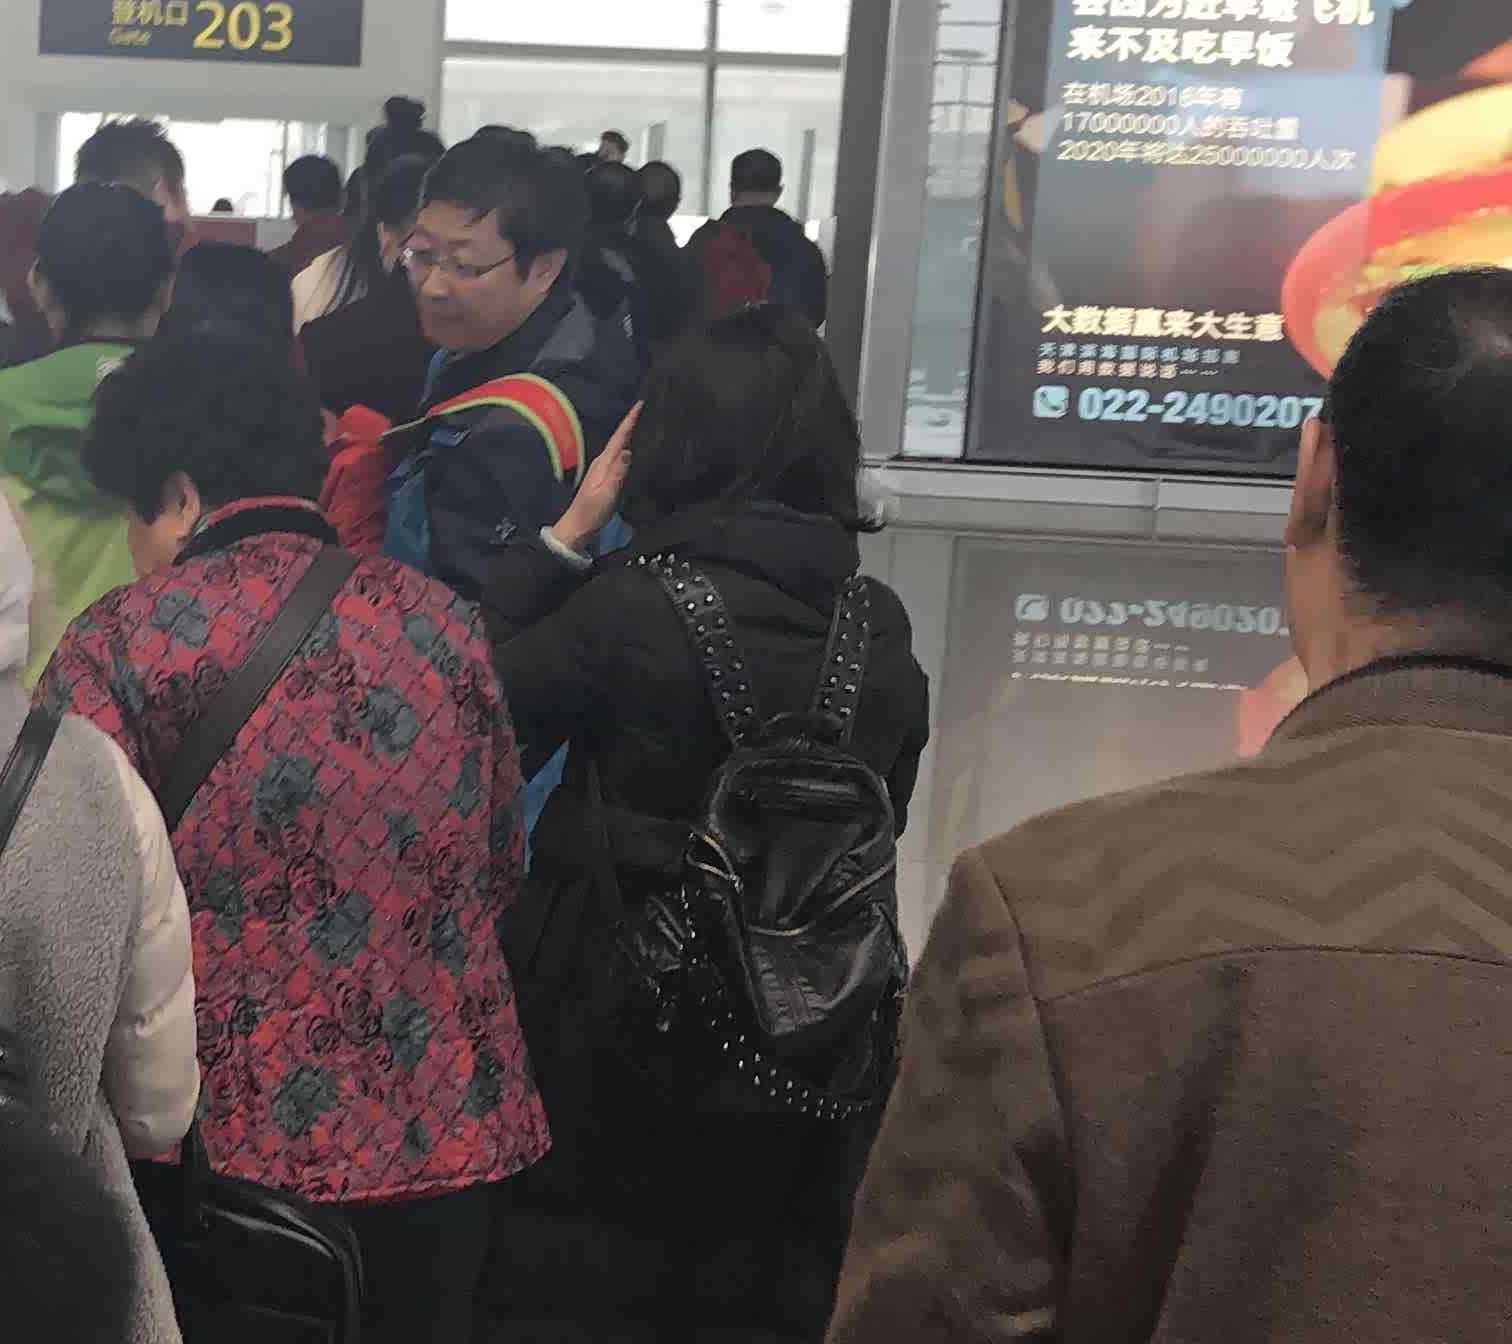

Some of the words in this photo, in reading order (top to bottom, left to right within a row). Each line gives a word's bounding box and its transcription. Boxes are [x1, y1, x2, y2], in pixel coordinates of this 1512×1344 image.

[192, 0, 293, 51] 203
[1067, 25, 1295, 67] 来不及吃早饭
[1041, 304, 1286, 342] 大数据赢来大生意
